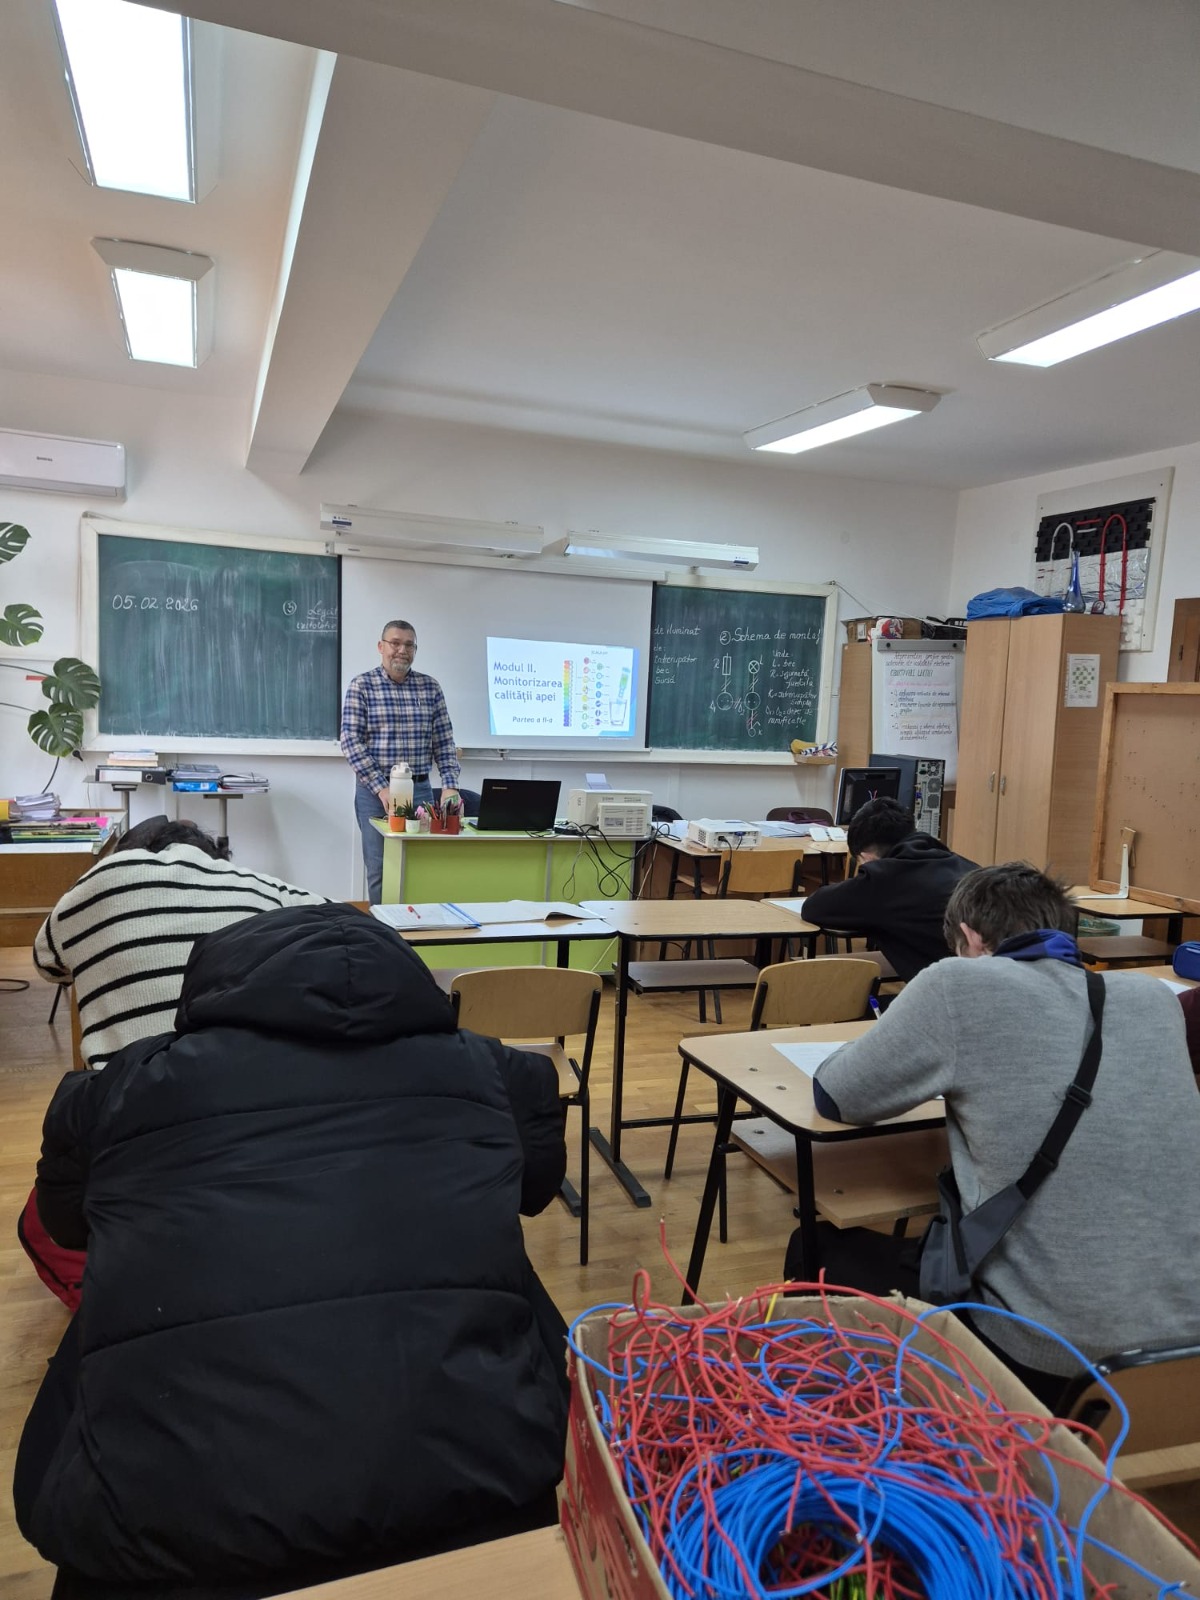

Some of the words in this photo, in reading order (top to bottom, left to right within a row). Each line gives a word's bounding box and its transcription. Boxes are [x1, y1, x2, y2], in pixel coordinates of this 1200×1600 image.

[732, 627, 771, 642] Schema
[774, 629, 786, 640] de
[493, 661, 524, 672] Modul
[493, 676, 563, 688] Monitorizarea
[535, 692, 556, 703] apei
